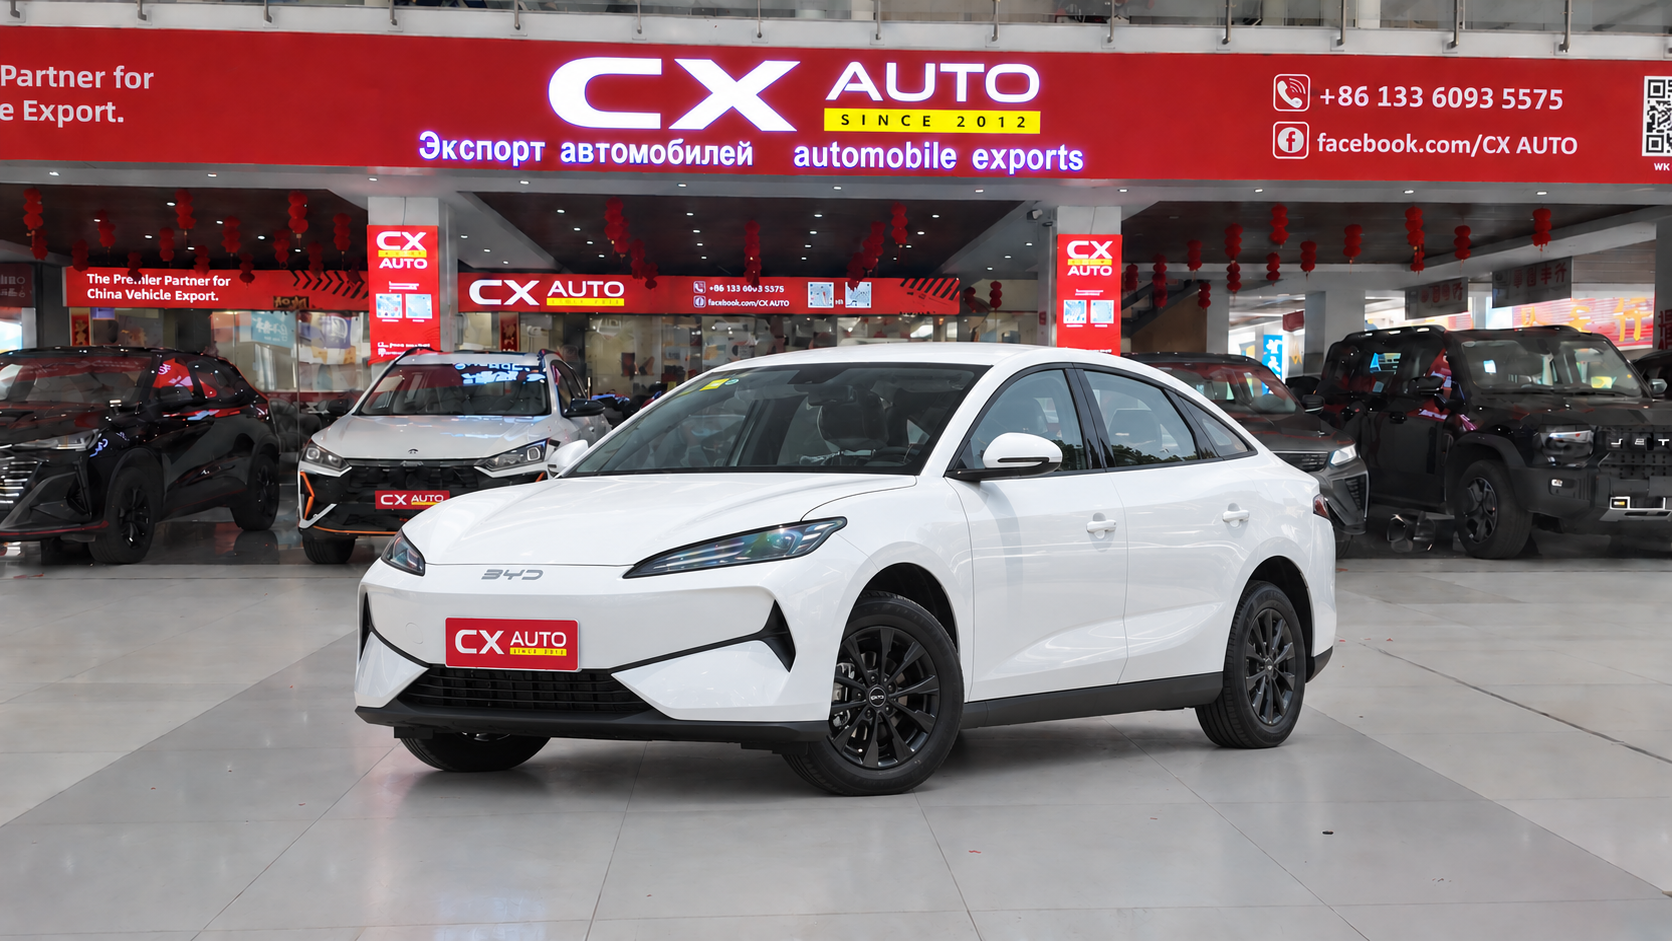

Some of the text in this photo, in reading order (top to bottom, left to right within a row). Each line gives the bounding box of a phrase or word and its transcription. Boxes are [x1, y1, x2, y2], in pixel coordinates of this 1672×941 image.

[0, 64, 155, 89] Partner for
[548, 57, 1040, 131] CX AUTO
[1319, 86, 1564, 110] +86 133 6093 5575
[23, 99, 124, 128] Export.
[841, 114, 1026, 128] SINCE 2012
[418, 130, 754, 167] Экспорт автомобилей
[1316, 132, 1580, 158] facebook.com/CX AUTO
[793, 141, 1085, 175] automobile exports
[1653, 162, 1670, 171] WK
[376, 230, 427, 251] CX
[1066, 240, 1113, 259] CX
[379, 257, 428, 269] AUTO
[1067, 265, 1113, 276] AUTO
[86, 273, 111, 285] The
[164, 275, 211, 287] Partner
[212, 275, 232, 287] for
[726, 284, 741, 293] 133
[86, 287, 219, 304] China Vehicle Export.
[468, 279, 625, 306] CX AUTO
[769, 299, 790, 307] AUTO
[380, 494, 444, 506] CX AUTO
[481, 569, 544, 580] BYD
[454, 629, 567, 655] CX AUTO
